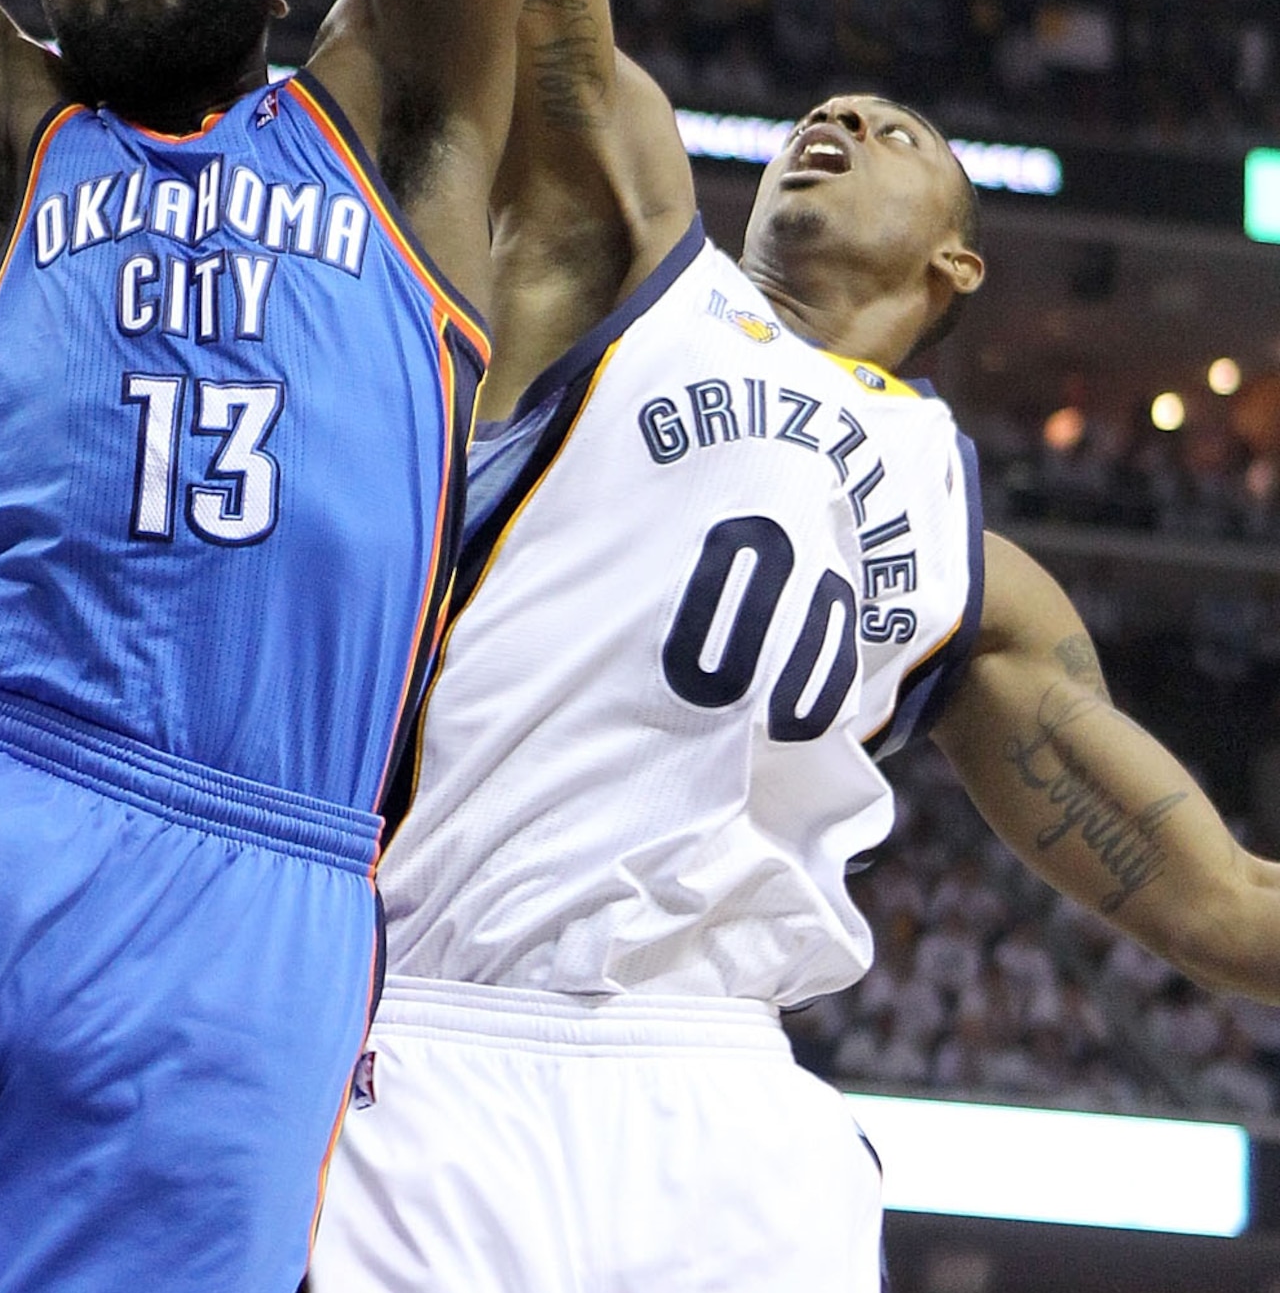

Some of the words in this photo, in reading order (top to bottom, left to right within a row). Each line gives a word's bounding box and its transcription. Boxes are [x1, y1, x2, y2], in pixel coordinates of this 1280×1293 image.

[33, 153, 369, 279] OKLAHOMA
[115, 247, 277, 344] CITY
[121, 371, 284, 548] 13
[637, 377, 917, 645] GRIZZLIES
[661, 515, 859, 743] 00
